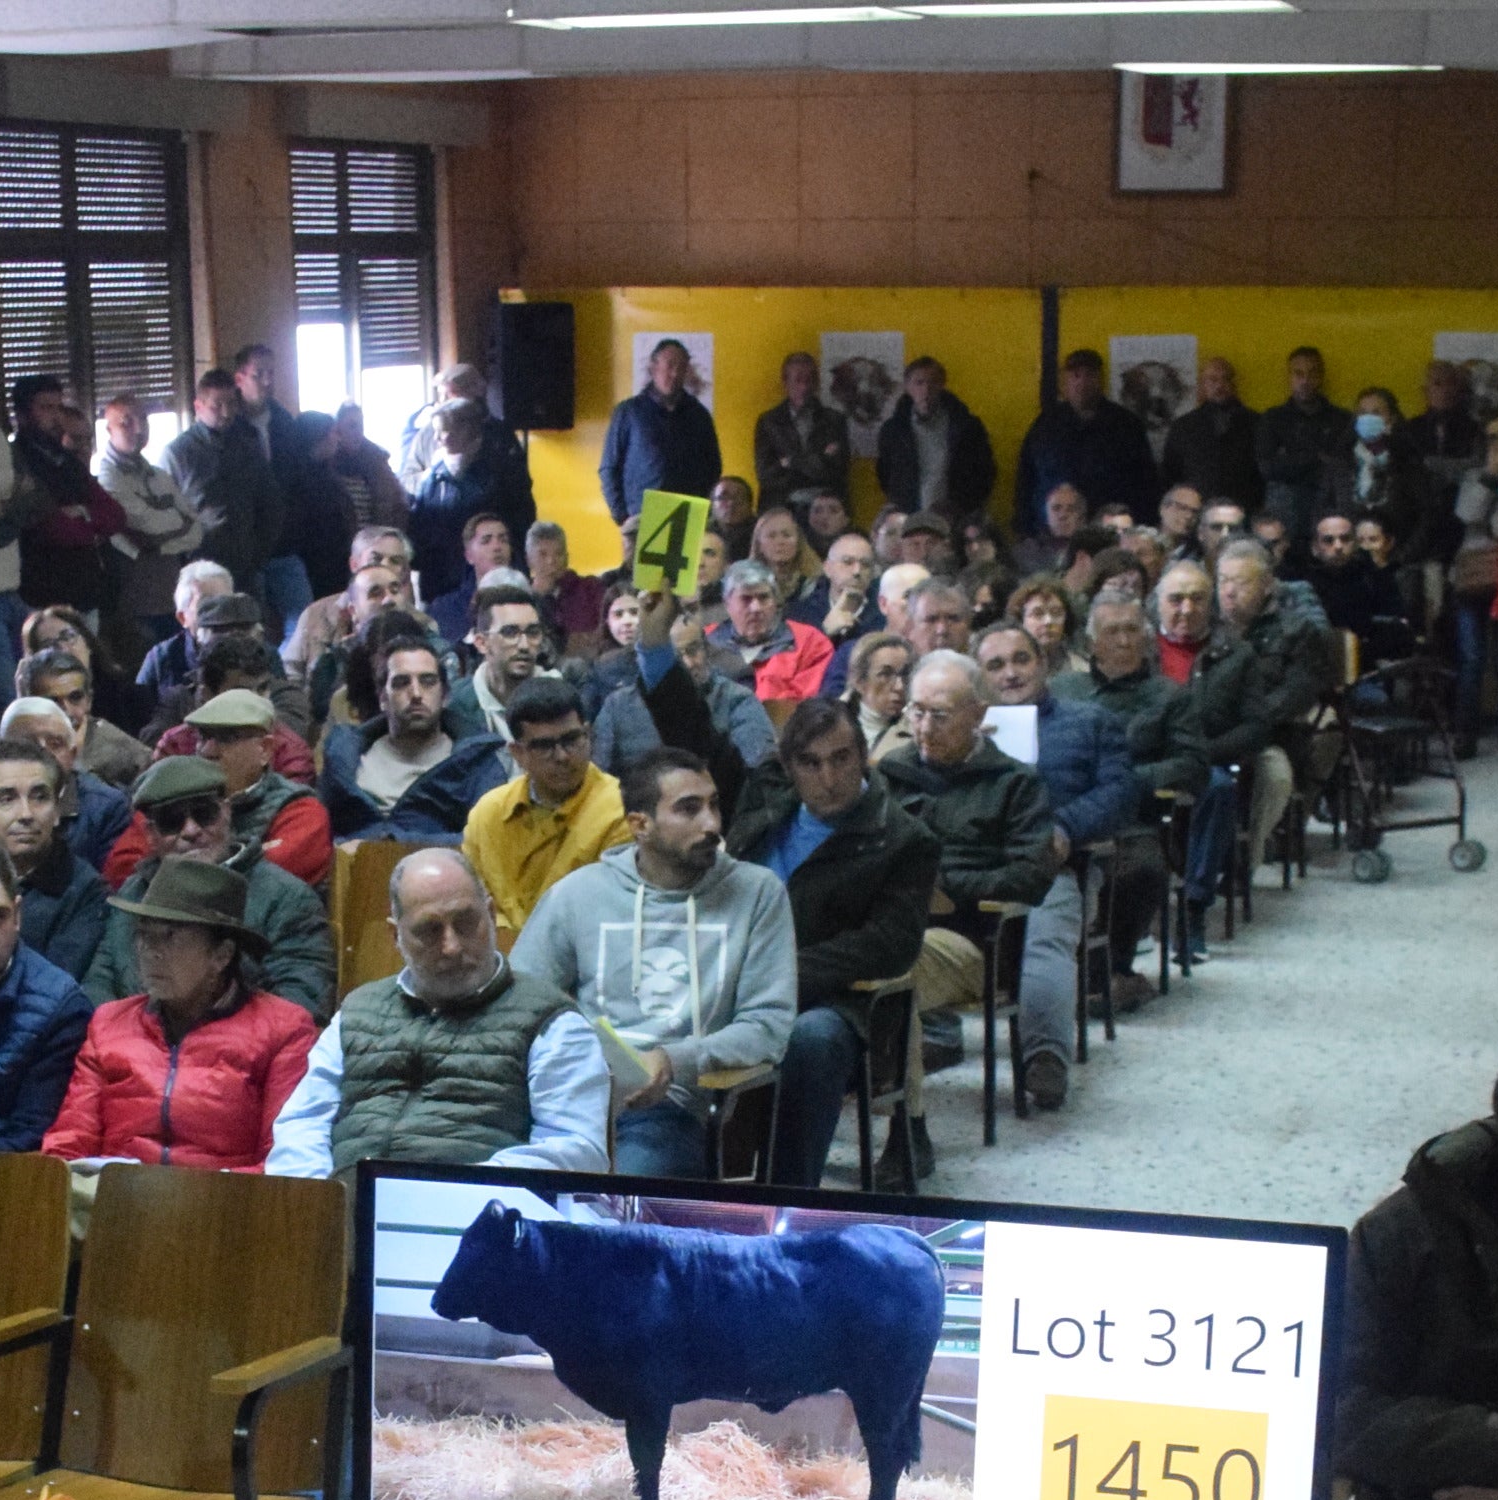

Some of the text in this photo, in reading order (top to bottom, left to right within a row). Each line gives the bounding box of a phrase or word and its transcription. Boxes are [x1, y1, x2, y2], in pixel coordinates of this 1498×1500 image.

[638, 501, 691, 588] 4
[1012, 1297, 1304, 1378] Lot 3121
